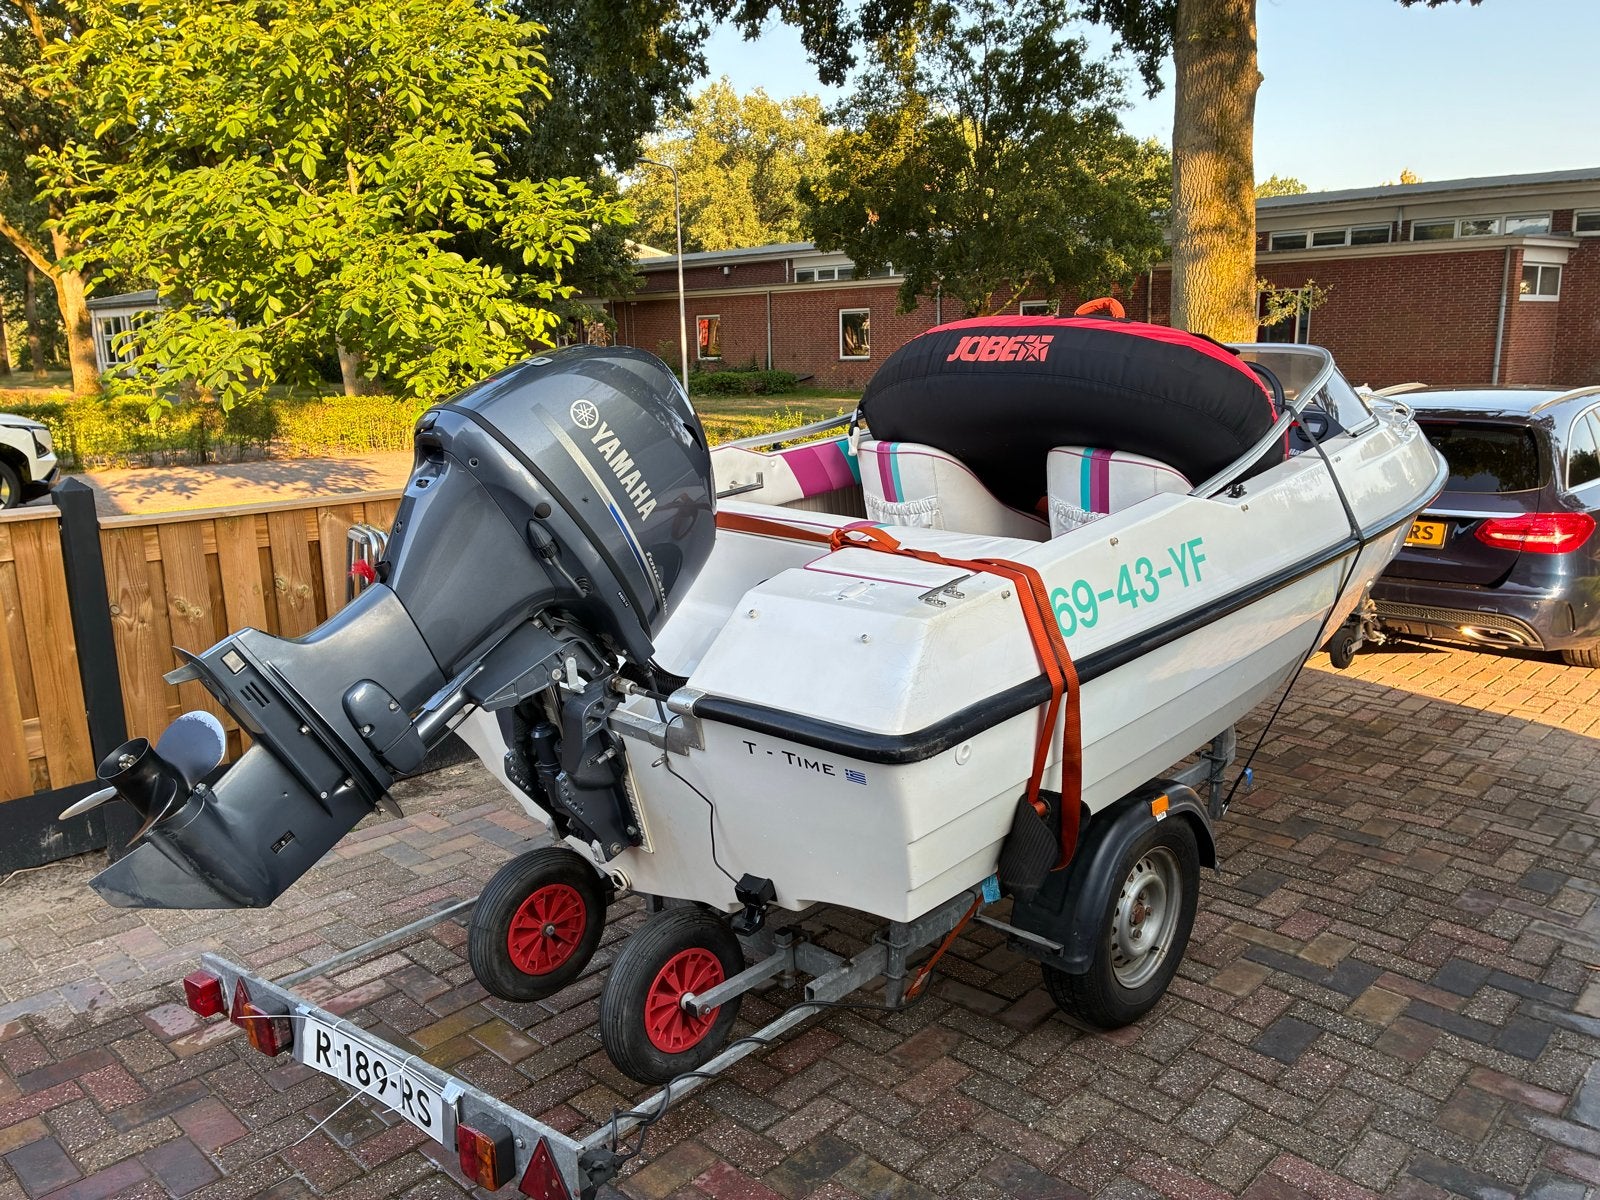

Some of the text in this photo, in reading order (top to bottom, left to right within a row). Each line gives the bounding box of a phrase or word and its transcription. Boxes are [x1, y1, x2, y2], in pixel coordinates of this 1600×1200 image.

[946, 335, 1026, 362] JOBE
[591, 421, 657, 522] YAMAHA
[1050, 537, 1206, 637] 69-43-YF
[782, 750, 835, 776] TIME
[316, 1029, 432, 1128] R-189-RS
